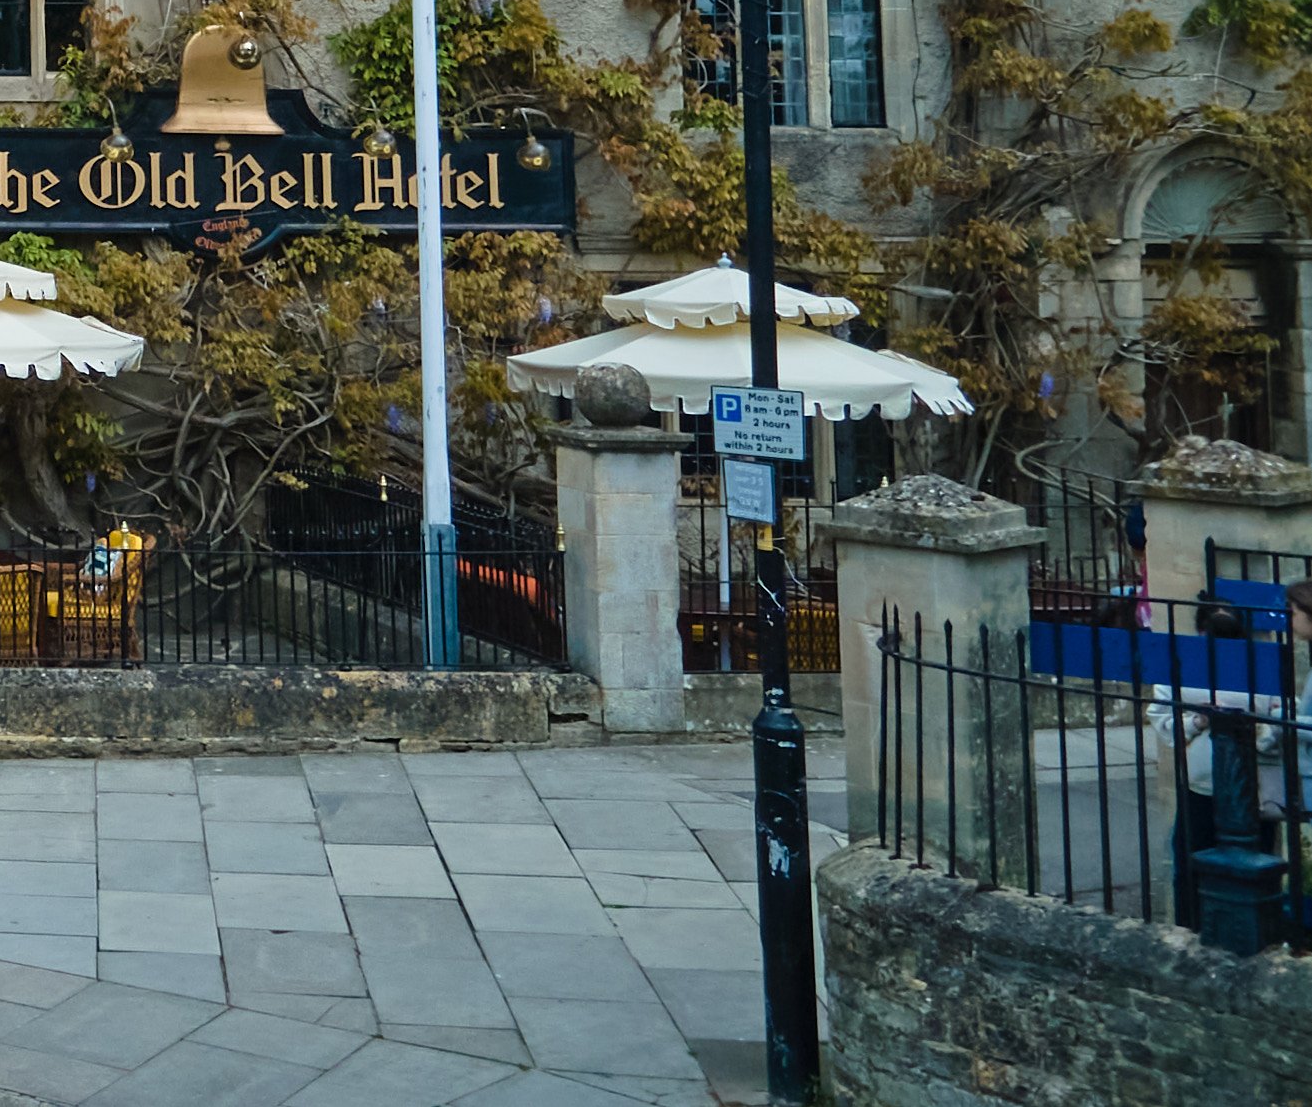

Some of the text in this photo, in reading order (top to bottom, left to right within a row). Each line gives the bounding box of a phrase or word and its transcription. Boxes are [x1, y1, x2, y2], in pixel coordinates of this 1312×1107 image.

[78, 151, 201, 210] Old
[213, 152, 339, 213] Bell
[748, 393, 770, 402] Mon
[777, 394, 795, 405] Sat
[721, 397, 738, 419] P
[753, 418, 791, 430] 2 hours
[734, 430, 782, 443] No return
[724, 442, 794, 455] within 2 hours
